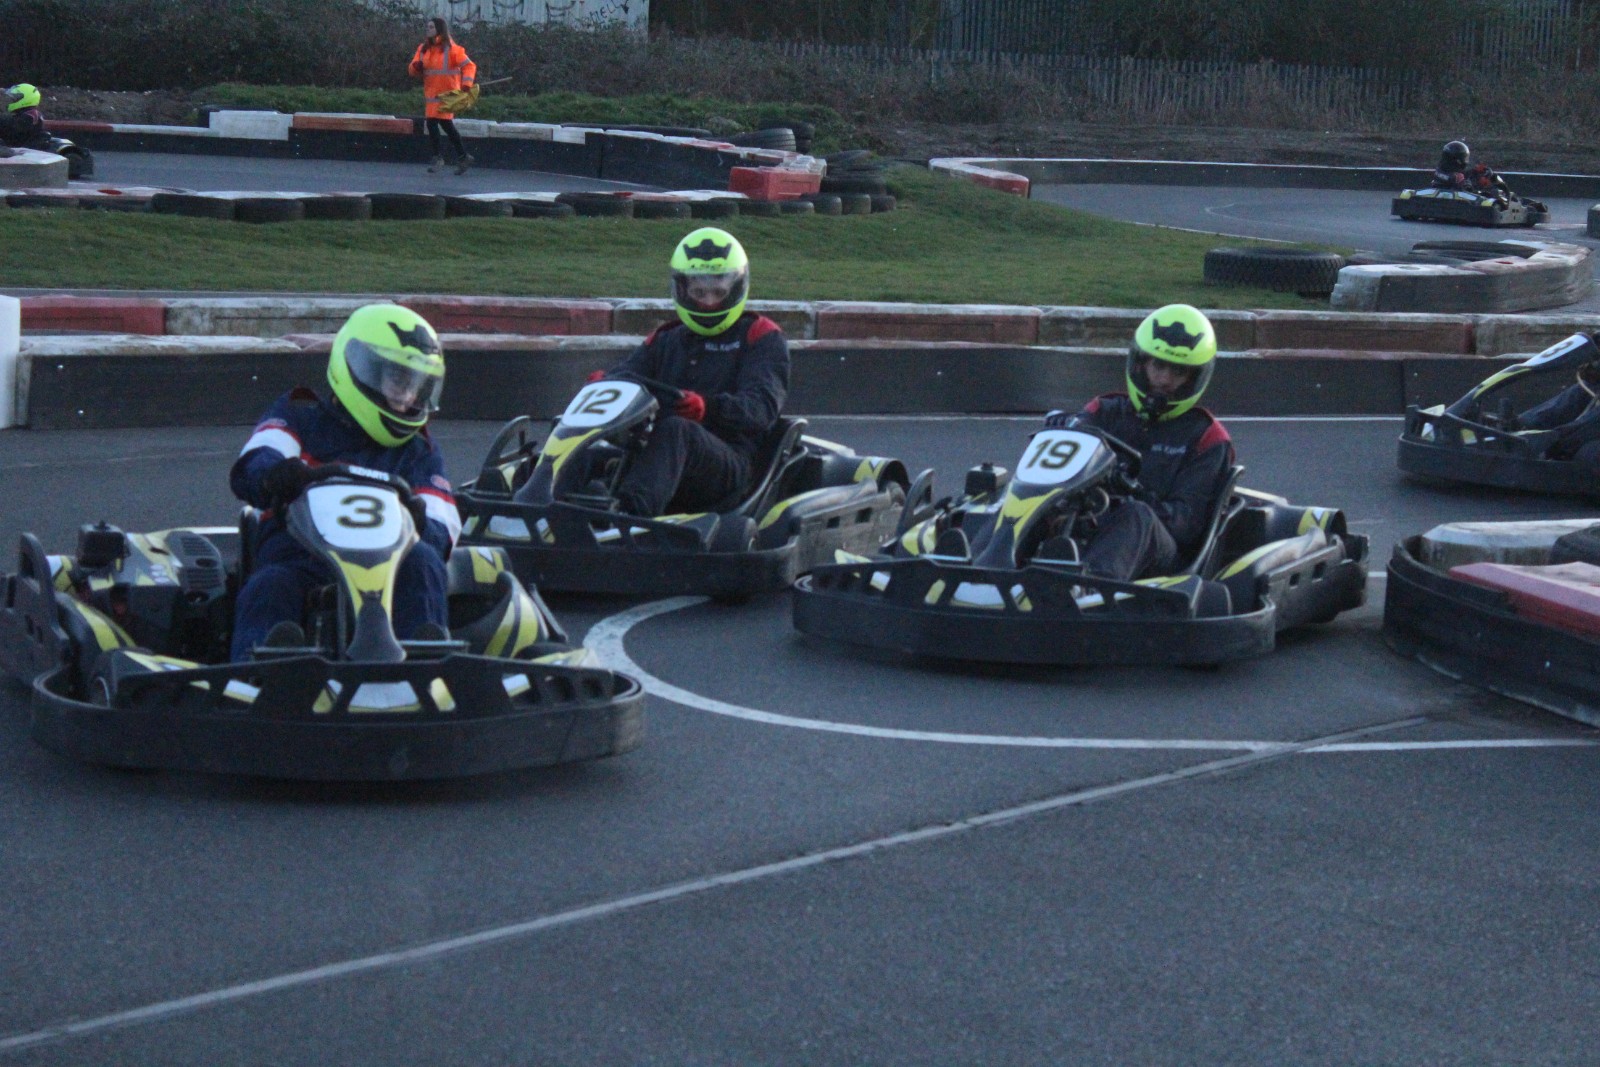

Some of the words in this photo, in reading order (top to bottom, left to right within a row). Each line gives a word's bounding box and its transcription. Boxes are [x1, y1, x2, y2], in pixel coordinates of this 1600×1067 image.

[571, 388, 622, 415] 12
[1026, 439, 1081, 469] 19
[337, 494, 385, 529] 3
